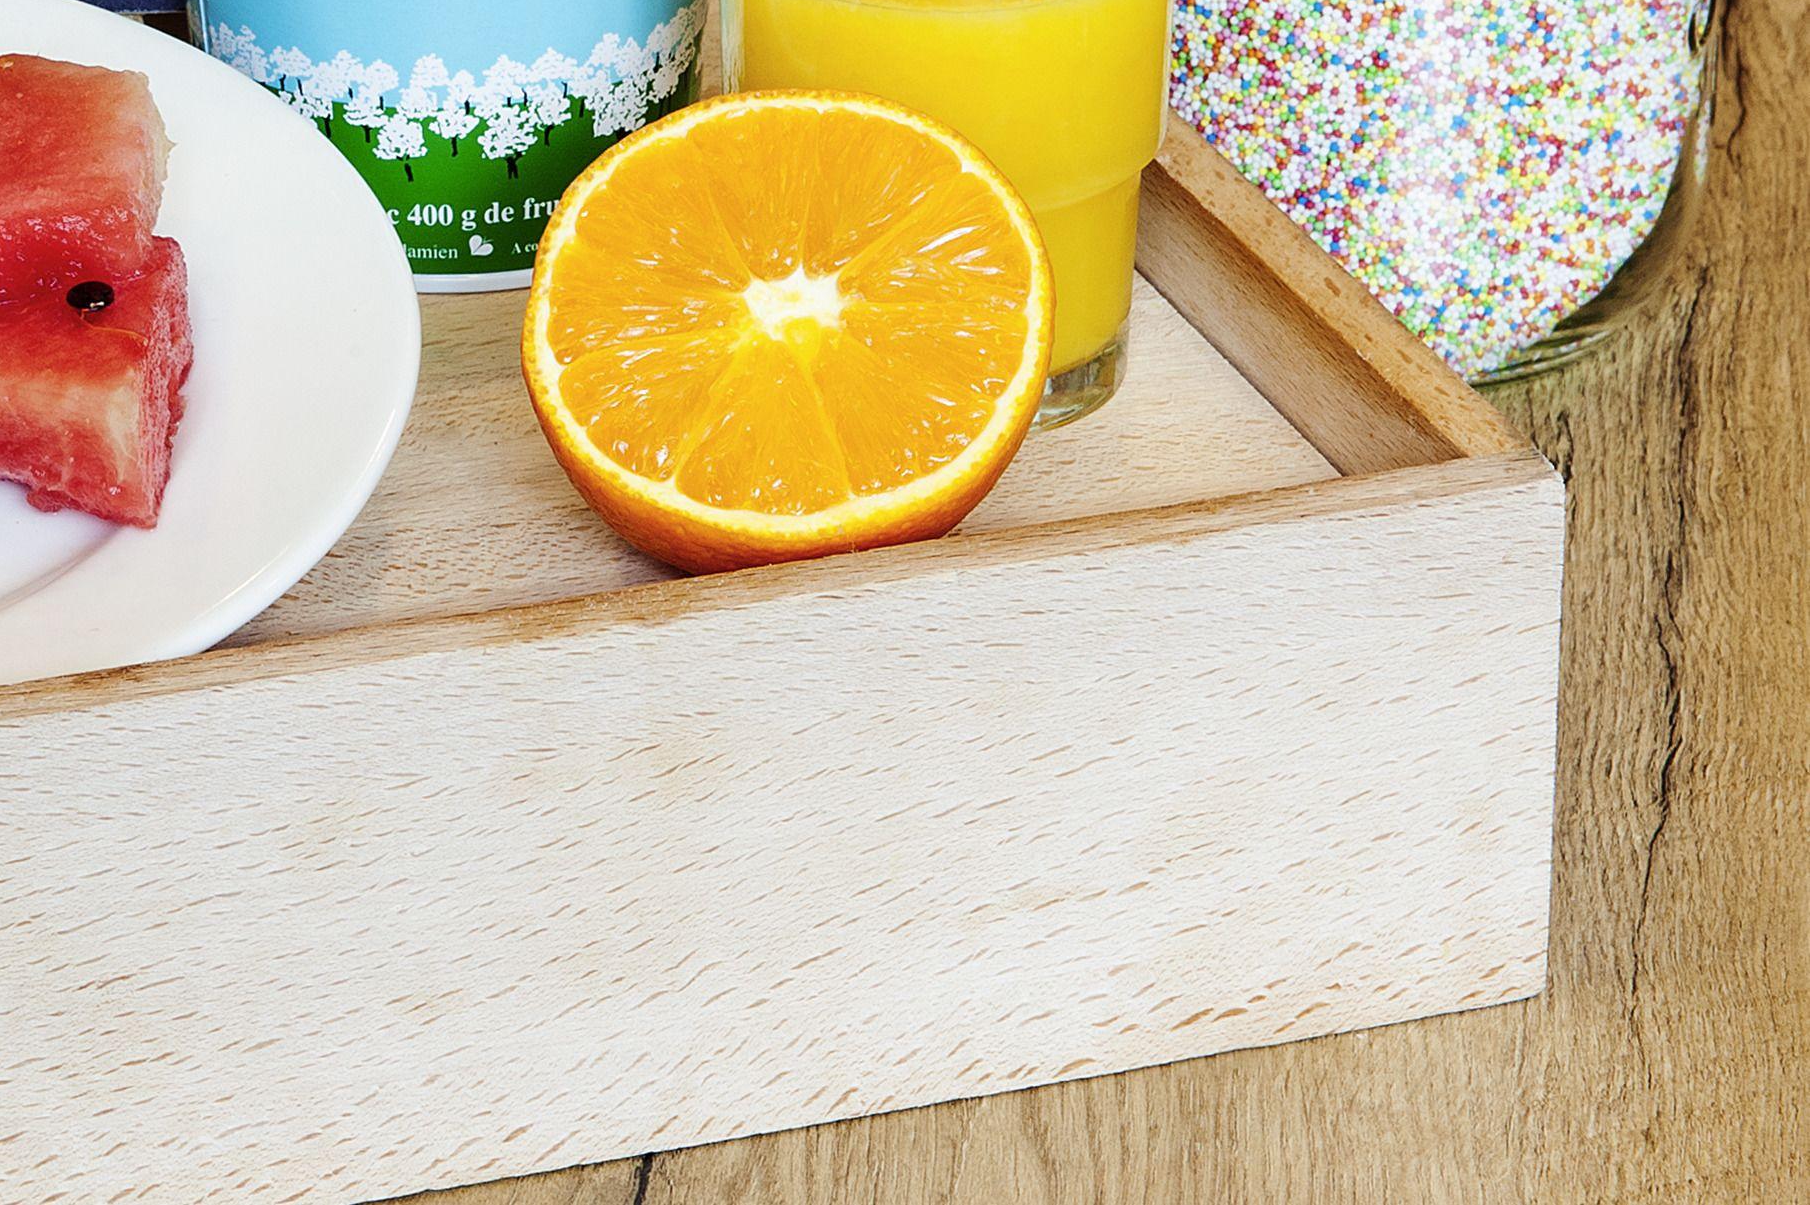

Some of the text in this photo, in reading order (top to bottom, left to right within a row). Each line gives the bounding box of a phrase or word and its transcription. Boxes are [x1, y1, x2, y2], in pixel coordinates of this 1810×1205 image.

[406, 203, 454, 227] 400
[461, 209, 478, 231] g
[483, 201, 515, 223] de
